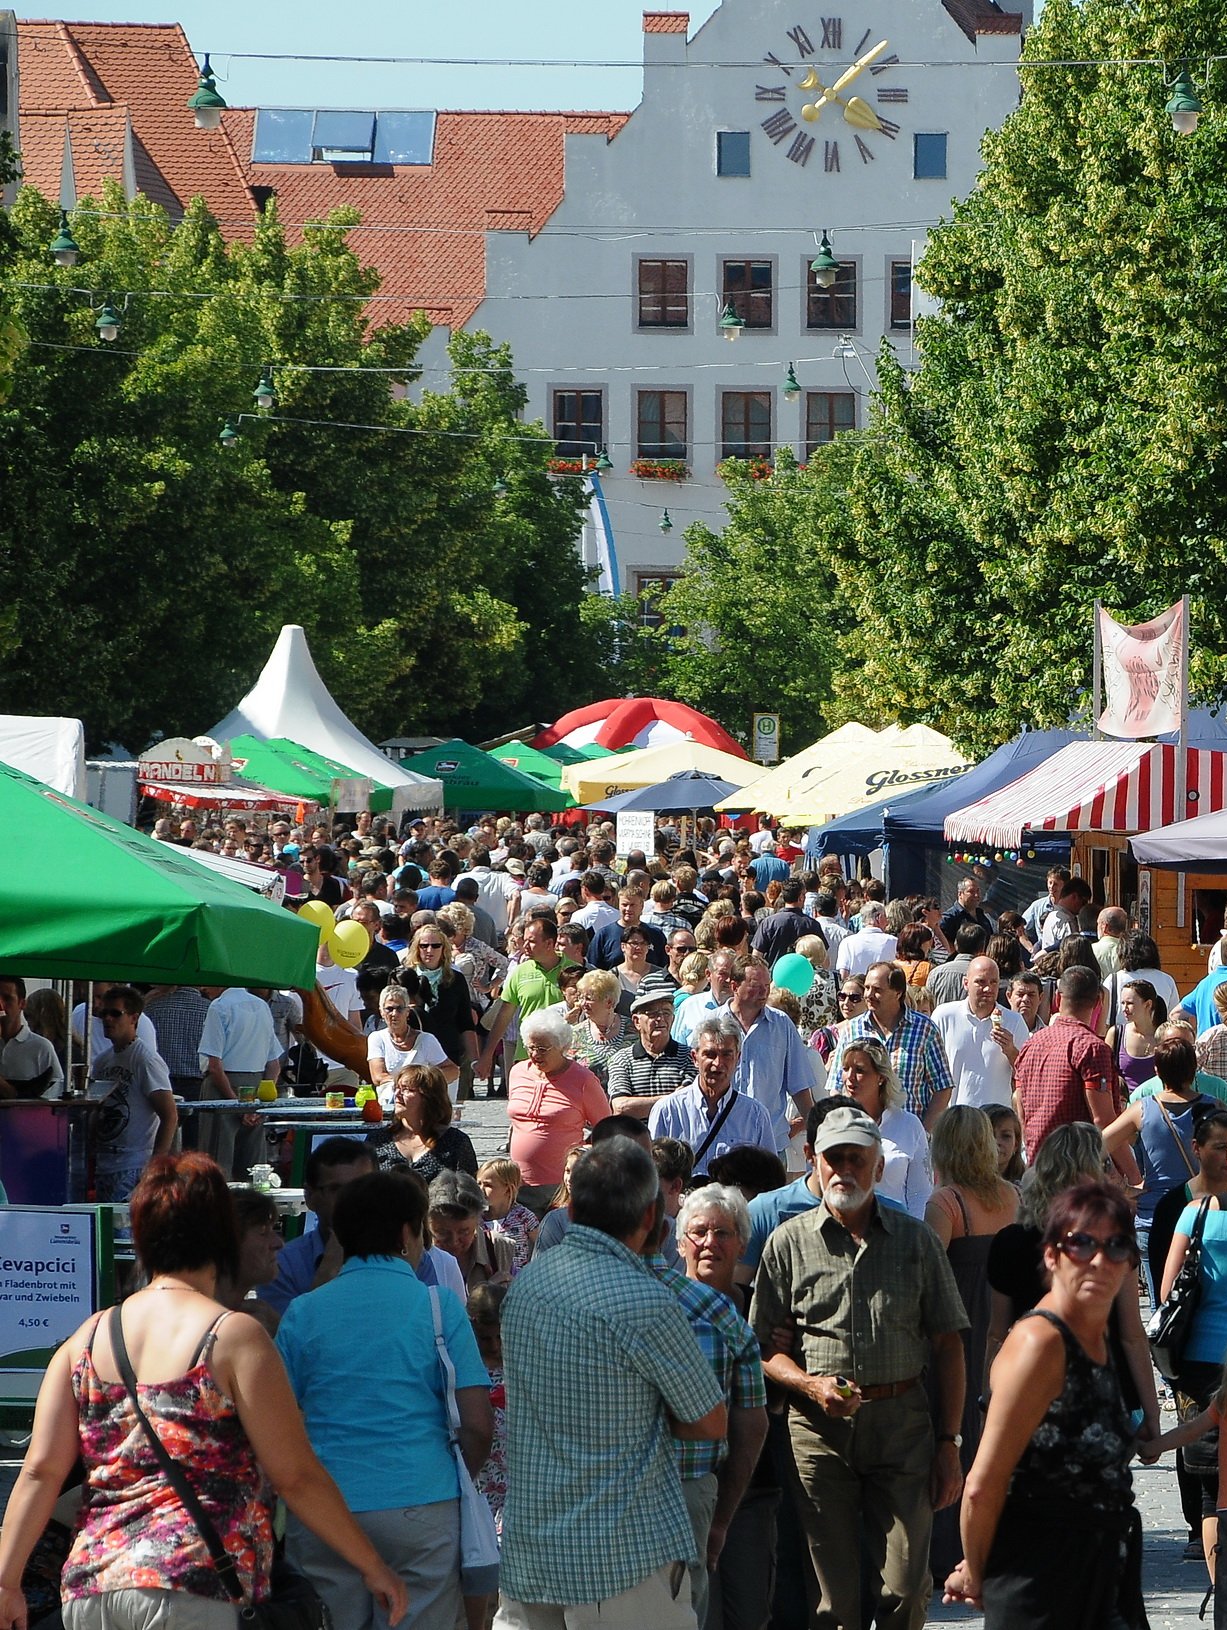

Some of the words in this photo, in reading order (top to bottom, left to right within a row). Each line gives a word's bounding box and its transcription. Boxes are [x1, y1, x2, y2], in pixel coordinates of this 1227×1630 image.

[820, 17, 842, 49] XII
[865, 763, 977, 796] Glossner
[0, 1257, 76, 1276] evapcici
[5, 1279, 57, 1290] Fladenbrot
[60, 1280, 76, 1290] mit
[15, 1293, 33, 1302] und
[35, 1293, 79, 1303] Zwiebeln
[18, 1318, 40, 1328] 4,50
[42, 1318, 49, 1328] €
